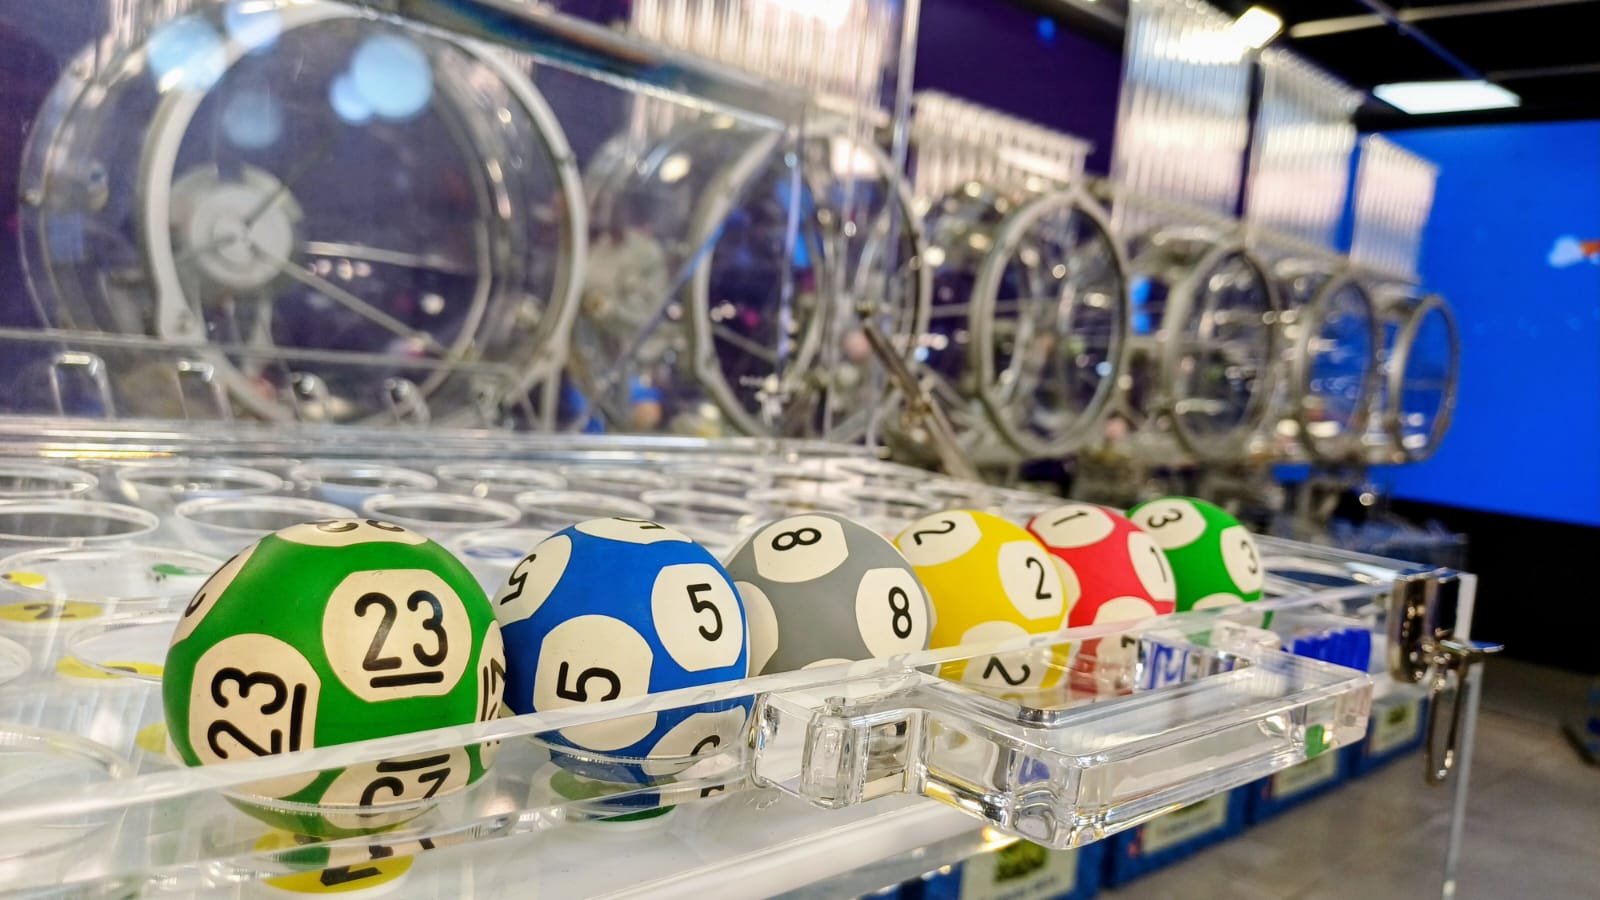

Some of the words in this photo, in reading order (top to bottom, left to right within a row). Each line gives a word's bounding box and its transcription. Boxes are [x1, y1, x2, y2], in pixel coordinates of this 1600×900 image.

[912, 520, 956, 546] 2
[1052, 510, 1089, 527] 1
[1147, 508, 1183, 529] 3
[771, 527, 822, 551] 8
[1025, 557, 1052, 600] 2
[1150, 546, 1167, 584] 1
[354, 590, 448, 671] 23
[686, 583, 723, 642] 5
[888, 586, 913, 639] 8
[556, 661, 621, 702] 5
[982, 656, 1031, 686] 2
[207, 667, 288, 759] 23
